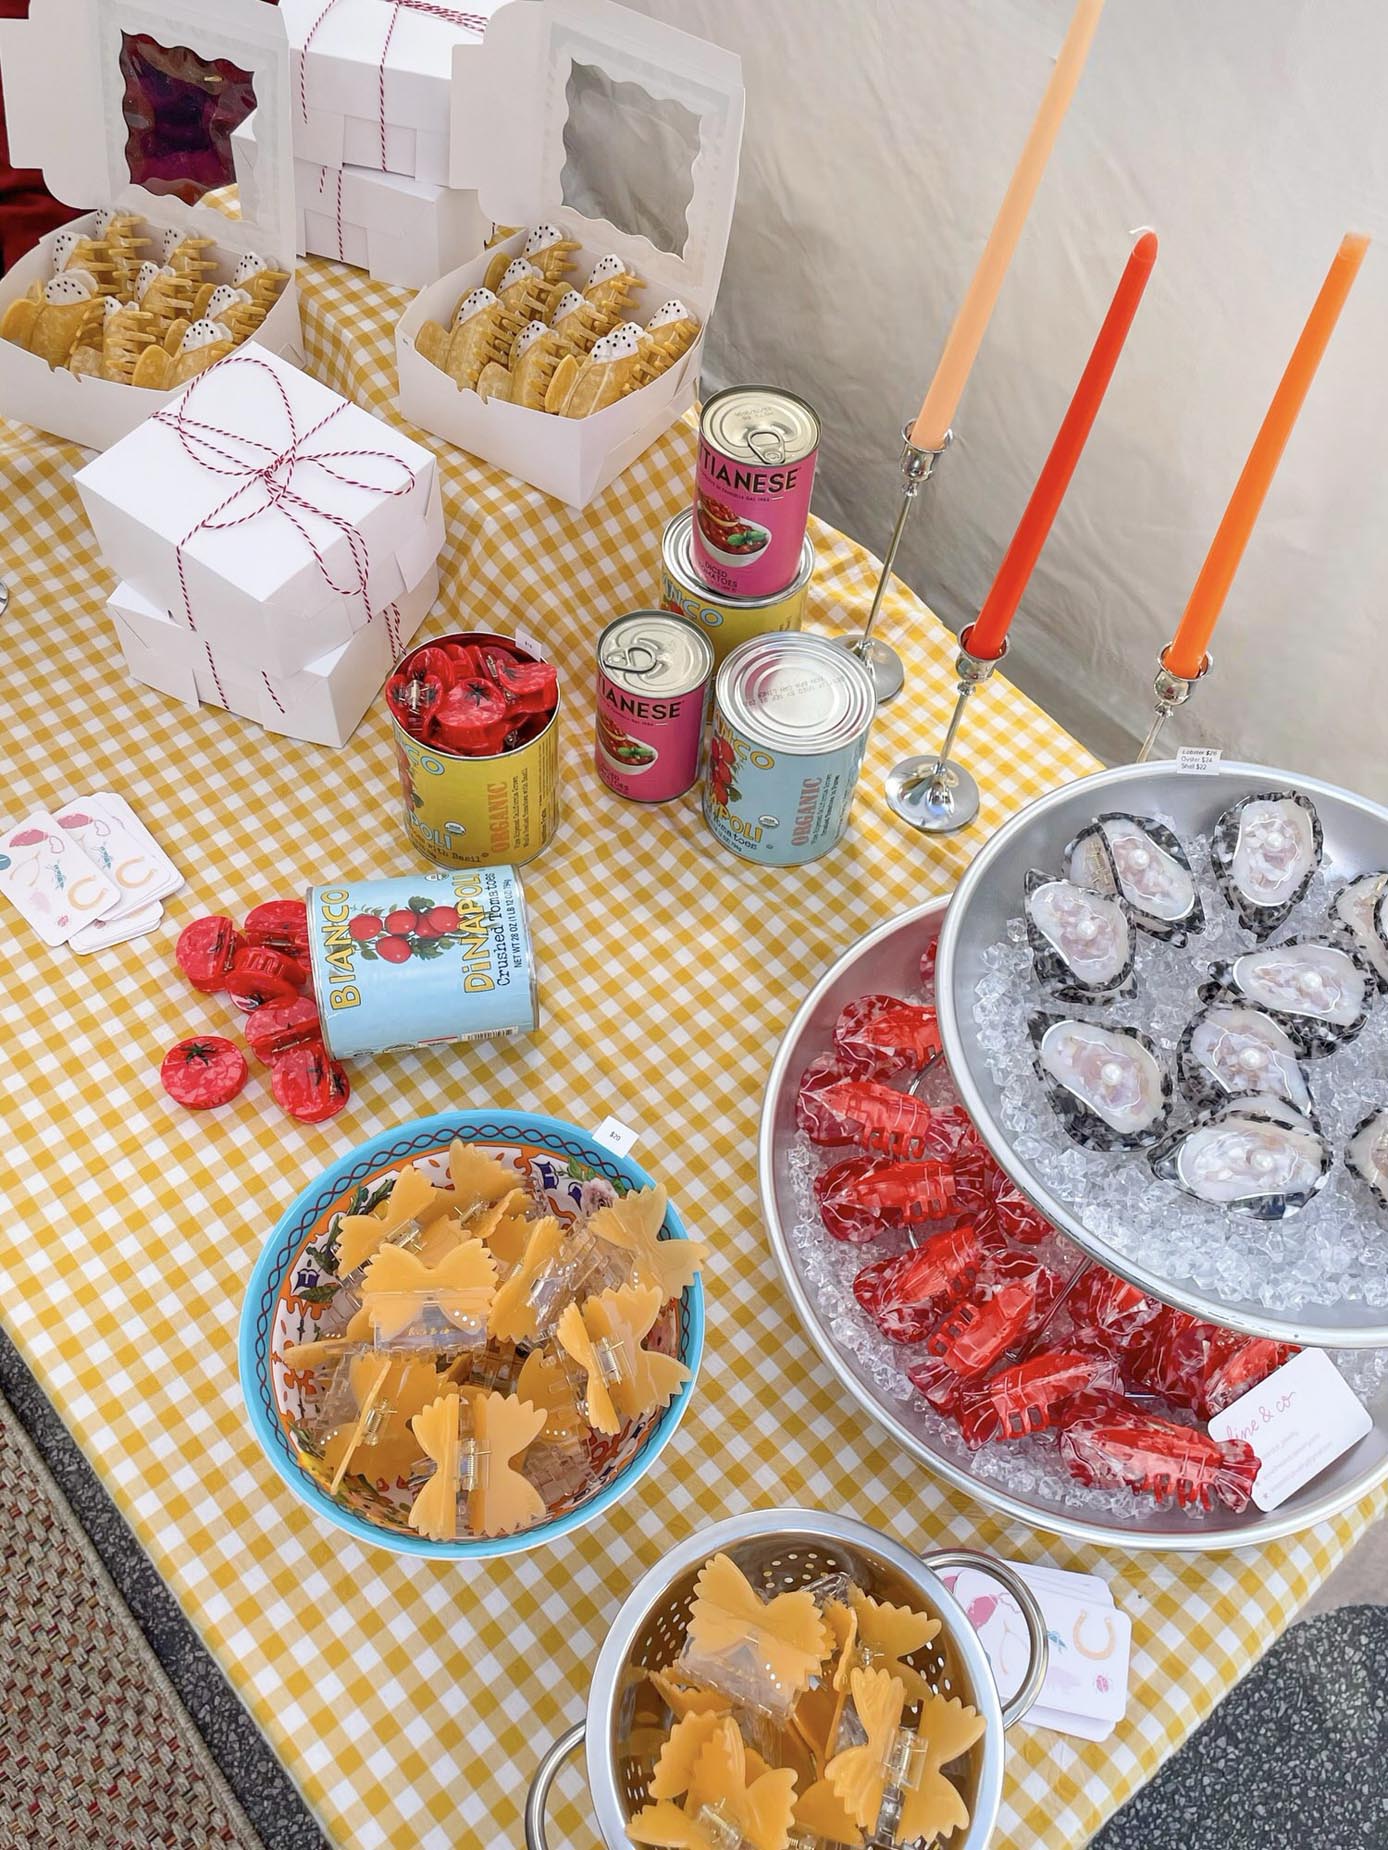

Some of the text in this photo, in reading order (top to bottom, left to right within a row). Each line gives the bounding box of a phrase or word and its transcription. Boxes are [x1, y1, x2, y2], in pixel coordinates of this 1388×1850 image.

[699, 442, 800, 493] TIANESE
[599, 678, 682, 720] IANESE
[487, 782, 511, 854] ORGANIC
[791, 777, 822, 846] ORGANIC
[505, 898, 514, 907] 12
[506, 906, 516, 915] LB
[485, 872, 511, 986] Crushed Tomatoes
[509, 921, 518, 932] OZ
[510, 932, 520, 942] 28
[320, 889, 361, 1010] BIANCO
[511, 942, 521, 955] WT
[513, 955, 522, 969] NET
[1258, 1406, 1275, 1423] &
